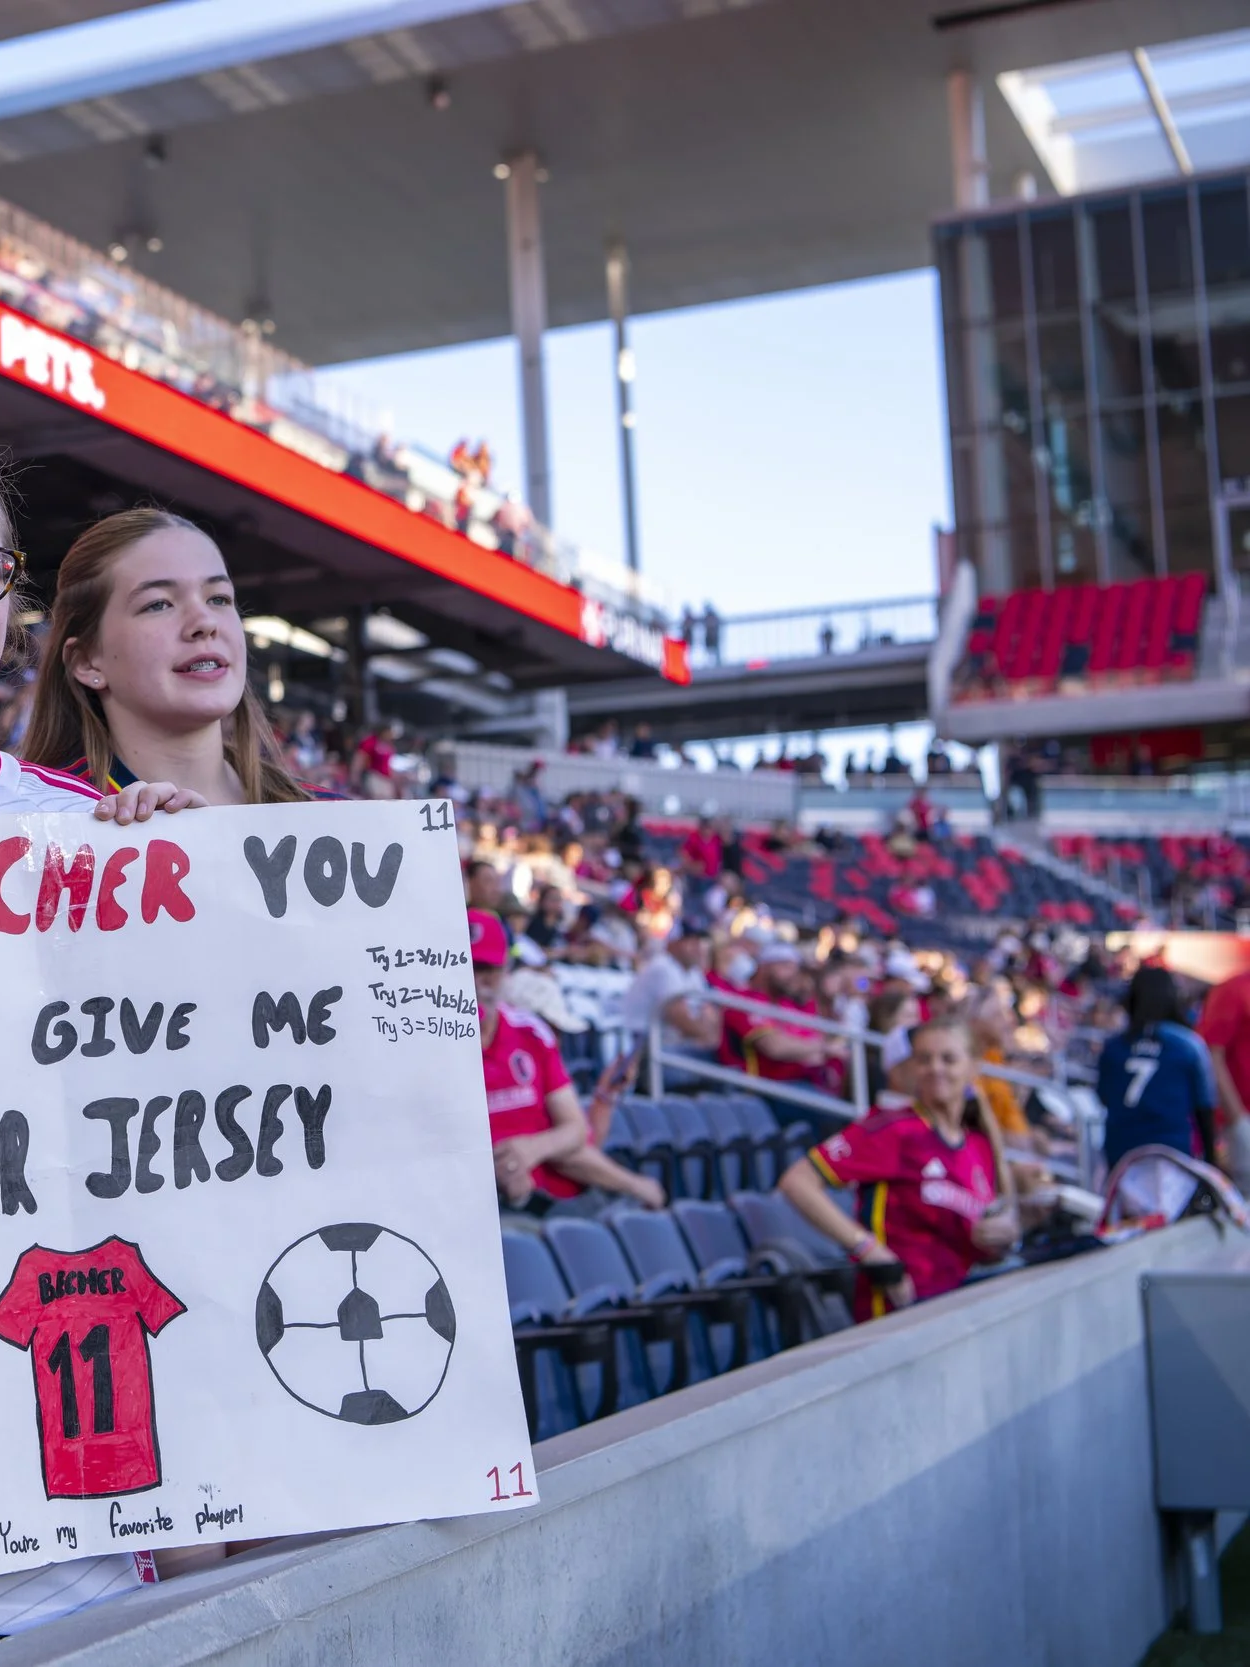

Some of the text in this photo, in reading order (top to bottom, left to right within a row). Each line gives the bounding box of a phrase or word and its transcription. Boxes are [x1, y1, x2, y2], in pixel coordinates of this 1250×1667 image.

[0, 312, 106, 411] PETS.
[419, 801, 454, 831] 11
[243, 834, 403, 918] YOU
[366, 945, 390, 972] Try
[368, 982, 397, 1008] Try
[31, 996, 197, 1065] GIVE
[252, 985, 343, 1049] ME
[371, 1016, 398, 1042] Try
[1123, 1056, 1160, 1109] 7
[82, 1084, 332, 1199] JERSEY
[38, 1268, 127, 1305] BECHER
[47, 1324, 116, 1439] 11
[487, 1462, 533, 1501] 11
[56, 1525, 78, 1550] my
